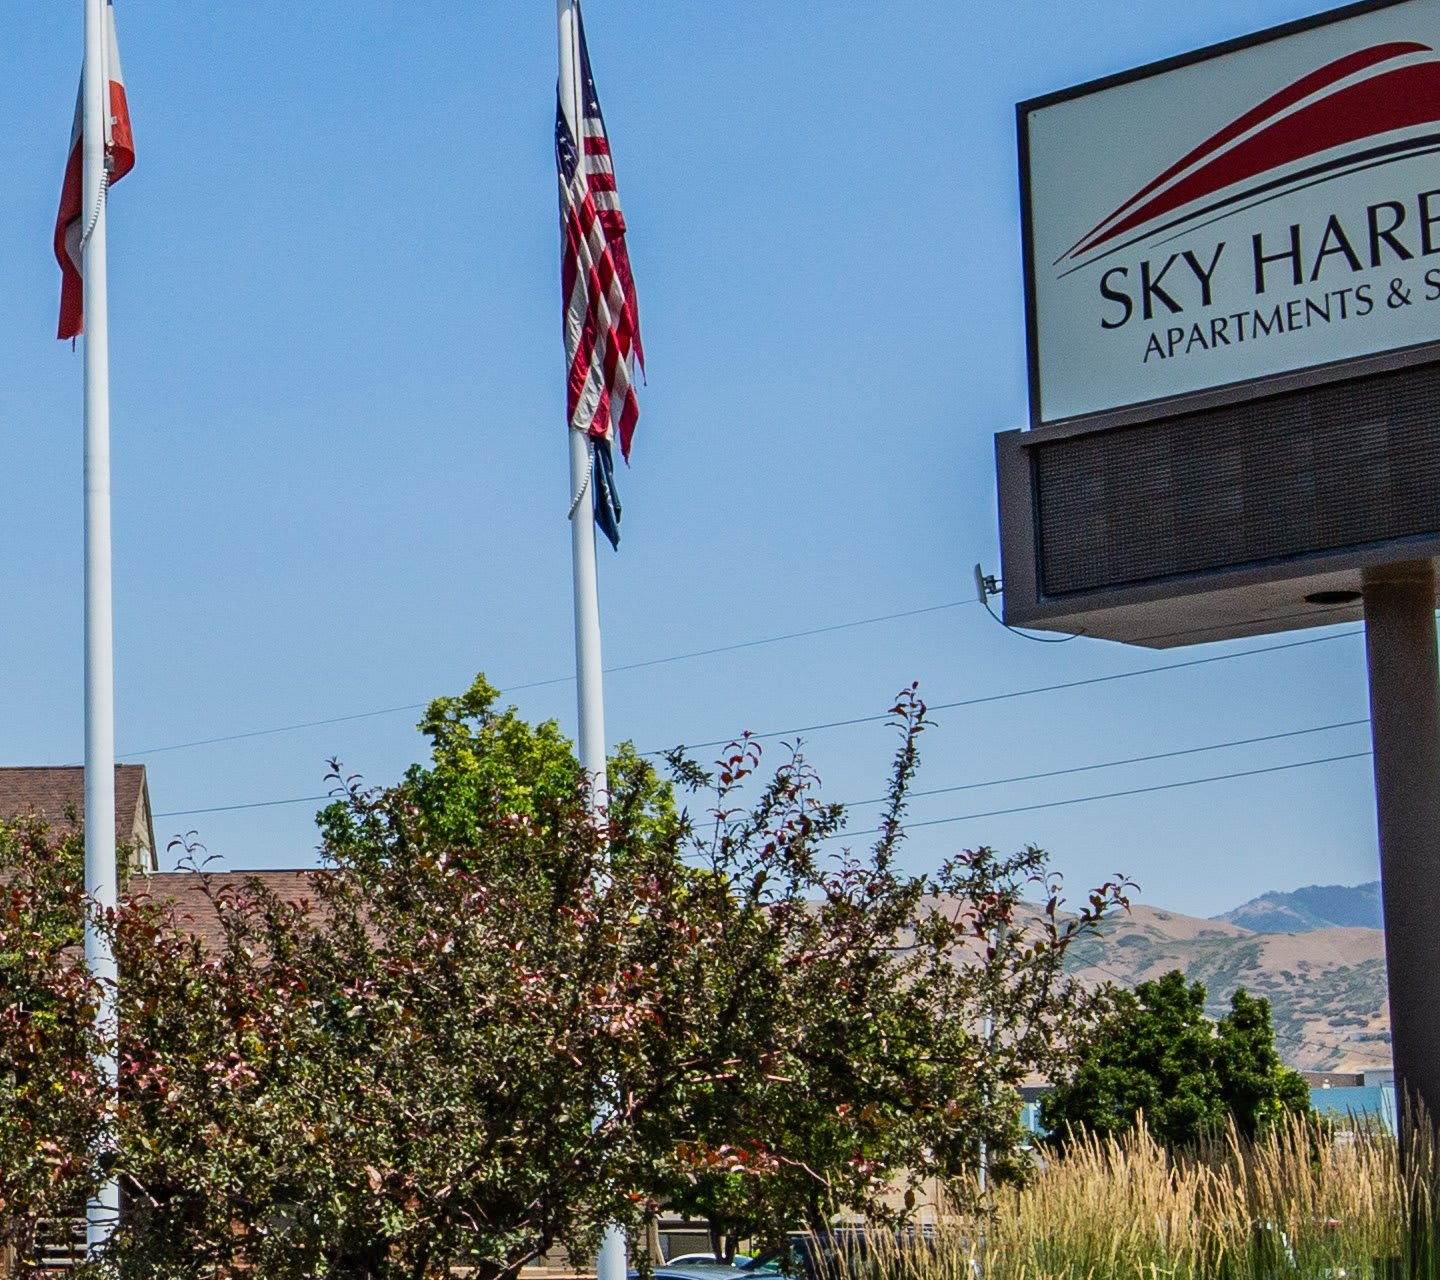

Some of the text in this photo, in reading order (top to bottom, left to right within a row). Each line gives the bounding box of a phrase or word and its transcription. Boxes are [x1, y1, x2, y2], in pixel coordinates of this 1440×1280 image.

[1099, 241, 1226, 330] SKY
[1143, 292, 1374, 364] APARTMENTS
[1386, 277, 1413, 310] &
